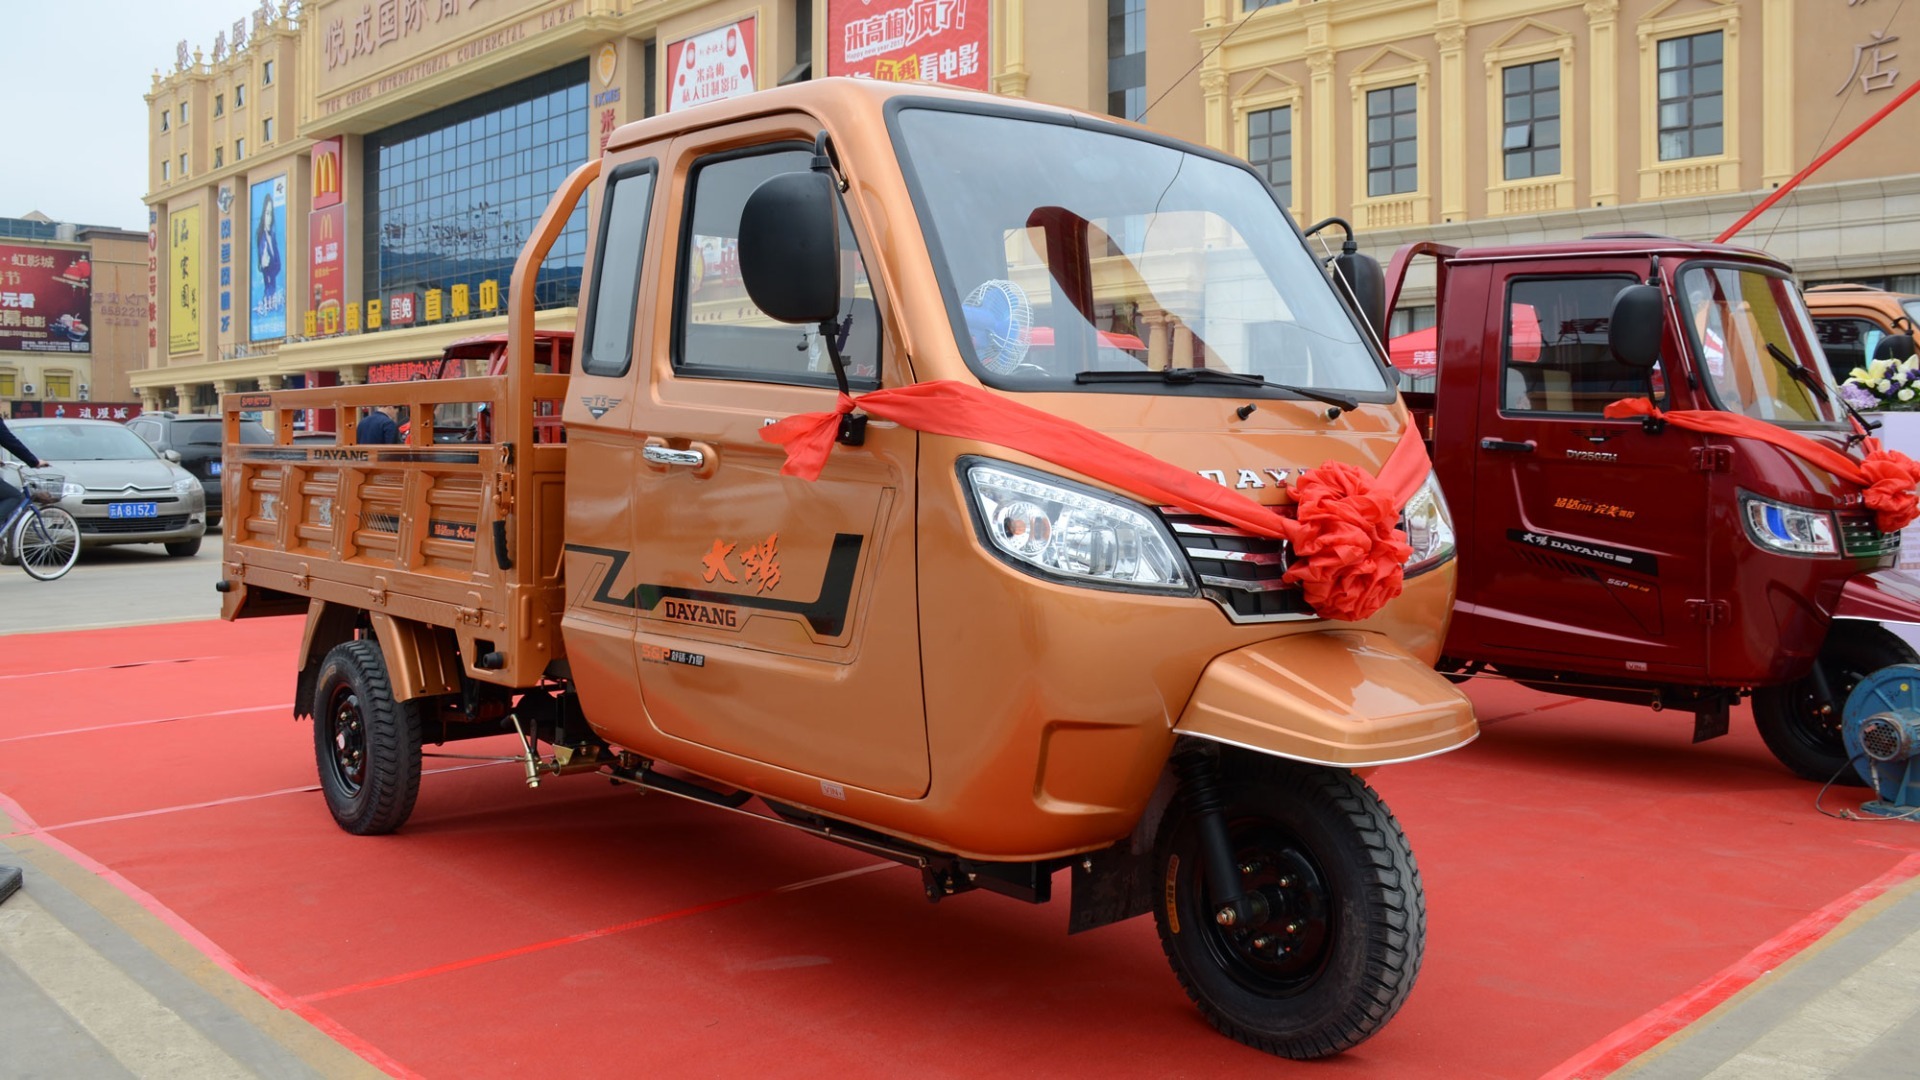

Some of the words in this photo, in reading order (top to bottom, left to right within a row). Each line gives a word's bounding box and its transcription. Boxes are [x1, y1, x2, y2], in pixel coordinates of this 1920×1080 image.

[325, 0, 484, 71] 悦成国际
[378, 52, 450, 94] INTERNATIONAL
[457, 24, 525, 62] COMMERCIAL
[541, 3, 576, 30] LAZA
[845, 42, 978, 82] 免费看电影
[313, 450, 369, 462] DAYANG
[1198, 468, 1309, 489] DAY
[1550, 540, 1615, 560] DAYANG
[665, 601, 737, 627] DAYANG
